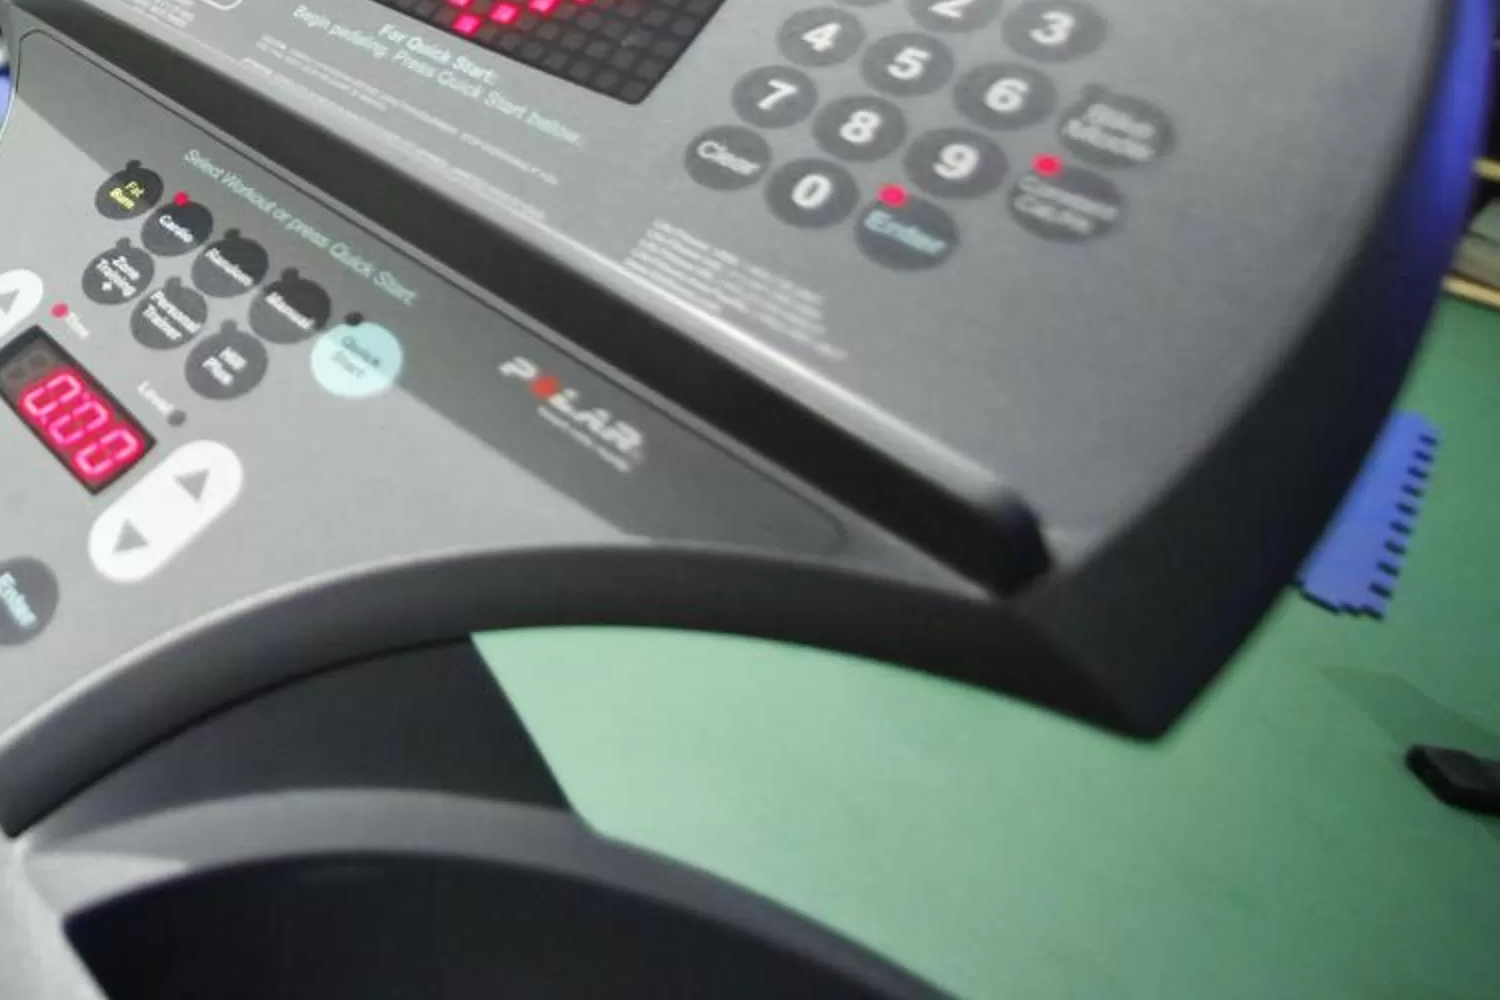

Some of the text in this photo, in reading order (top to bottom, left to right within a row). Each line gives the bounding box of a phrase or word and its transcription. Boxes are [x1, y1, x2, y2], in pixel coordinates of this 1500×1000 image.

[802, 22, 842, 53] 4
[1028, 11, 1077, 46] 3
[886, 46, 932, 81] 5
[757, 79, 797, 111] 7
[984, 77, 1030, 113] 6
[839, 109, 883, 145] 8
[932, 144, 981, 181] 9
[791, 173, 831, 210] 0
[863, 207, 949, 257] Enter
